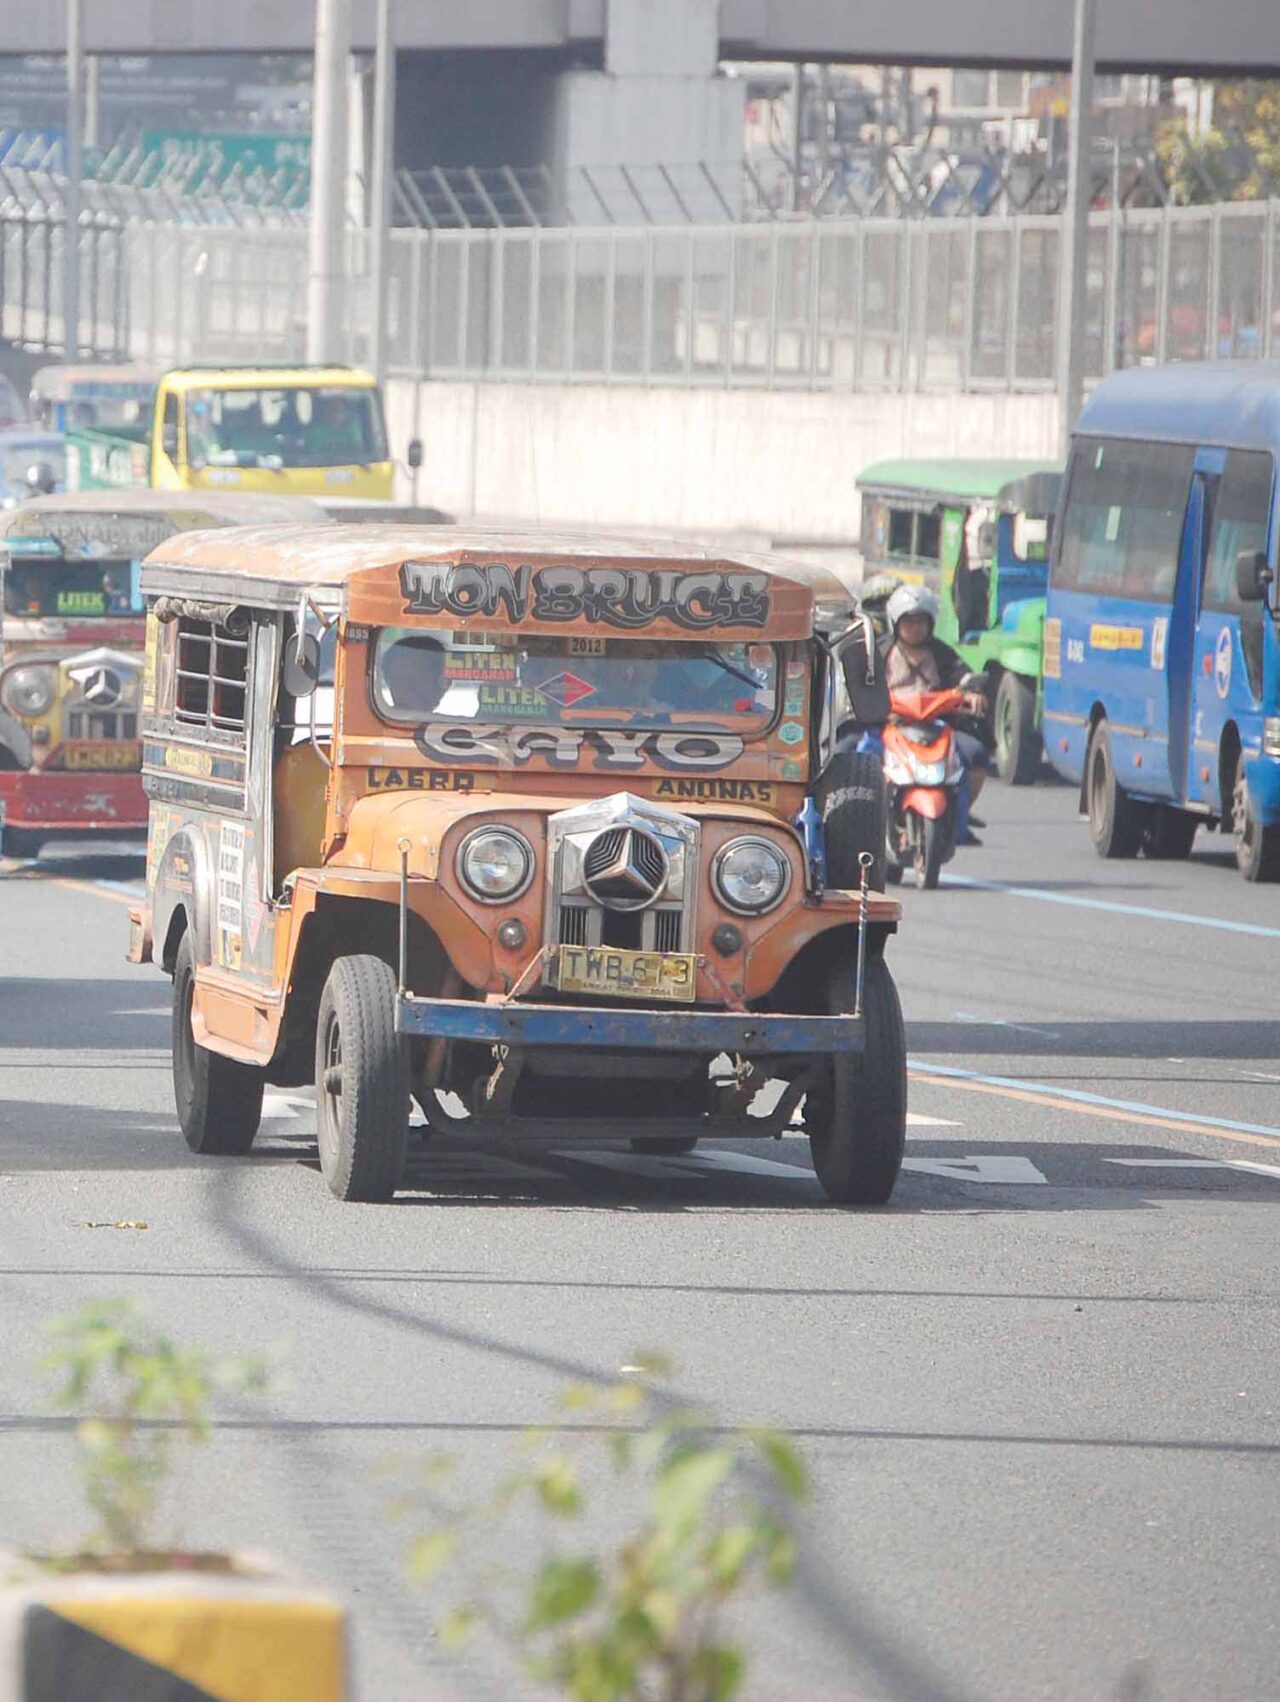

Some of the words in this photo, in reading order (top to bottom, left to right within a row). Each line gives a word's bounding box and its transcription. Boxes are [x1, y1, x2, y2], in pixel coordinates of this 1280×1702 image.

[398, 561, 532, 624] TON
[532, 565, 772, 630] BRUCE
[572, 639, 602, 653] 2012
[445, 652, 516, 669] LITEX
[566, 951, 622, 981] TWB
